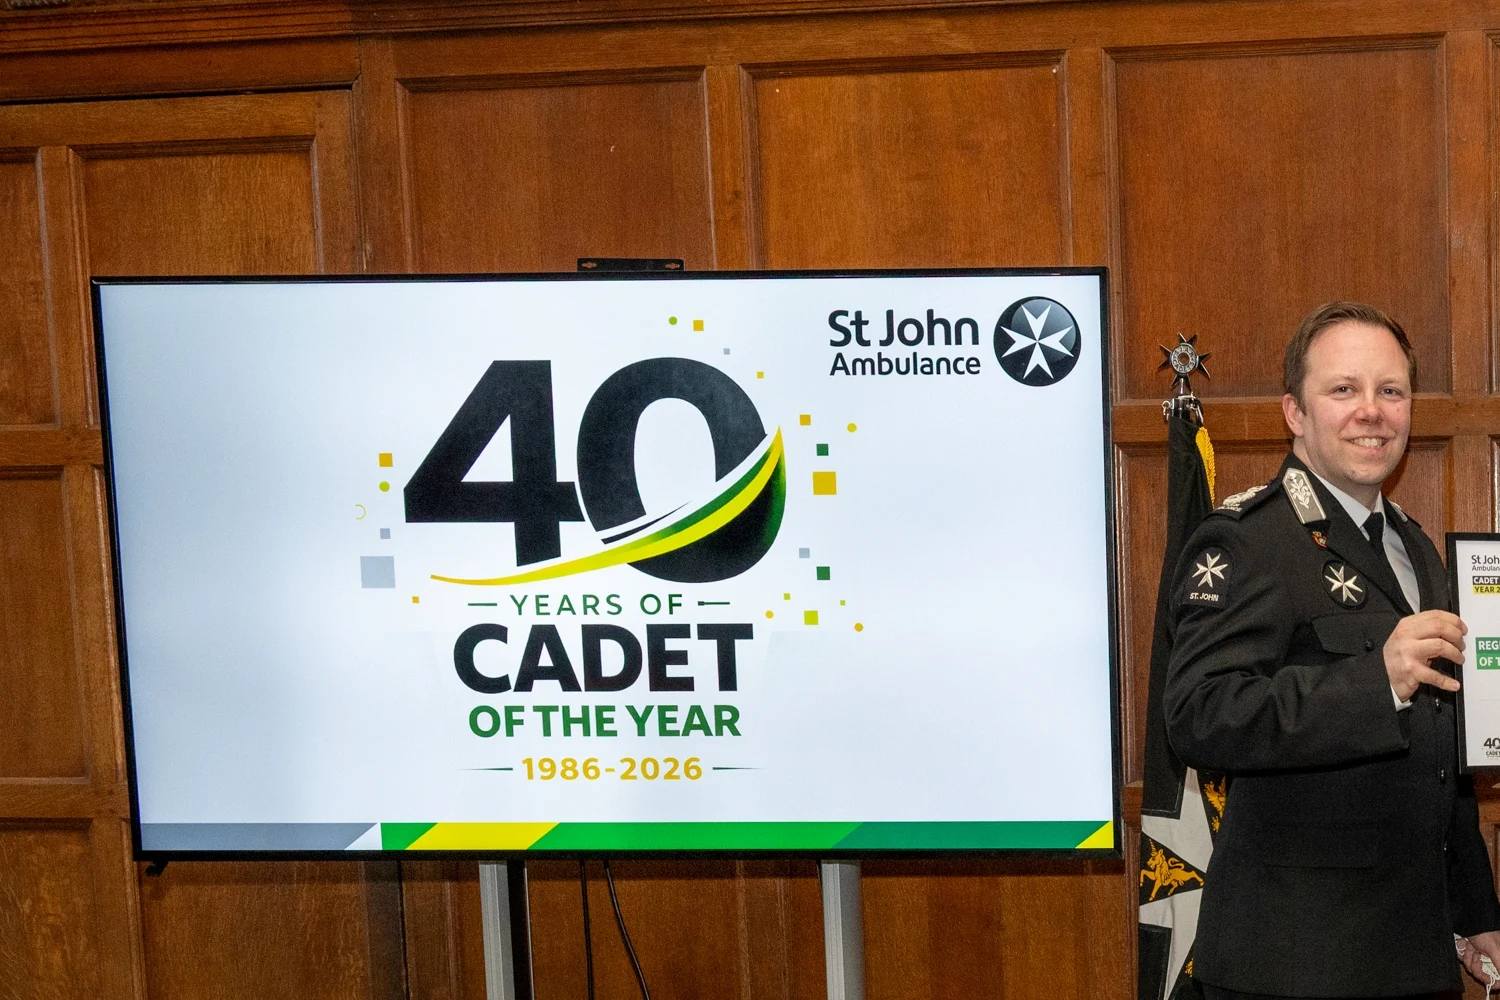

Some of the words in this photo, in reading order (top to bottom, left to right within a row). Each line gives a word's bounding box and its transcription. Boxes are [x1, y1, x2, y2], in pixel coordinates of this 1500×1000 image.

[828, 310, 871, 347] St
[879, 309, 979, 347] John
[830, 351, 981, 376] Ambulance
[402, 355, 787, 583] 40
[1471, 555, 1481, 564] St
[509, 594, 623, 616] YEARS
[640, 593, 683, 616] OF
[1190, 592, 1198, 600] ST.
[1199, 593, 1219, 601] JOHN
[453, 622, 754, 694] CADET
[1479, 657, 1493, 666] OF
[469, 705, 525, 738] OF
[533, 705, 618, 737] THE
[624, 704, 742, 737] YEAR
[521, 757, 703, 780] 1986-2026
